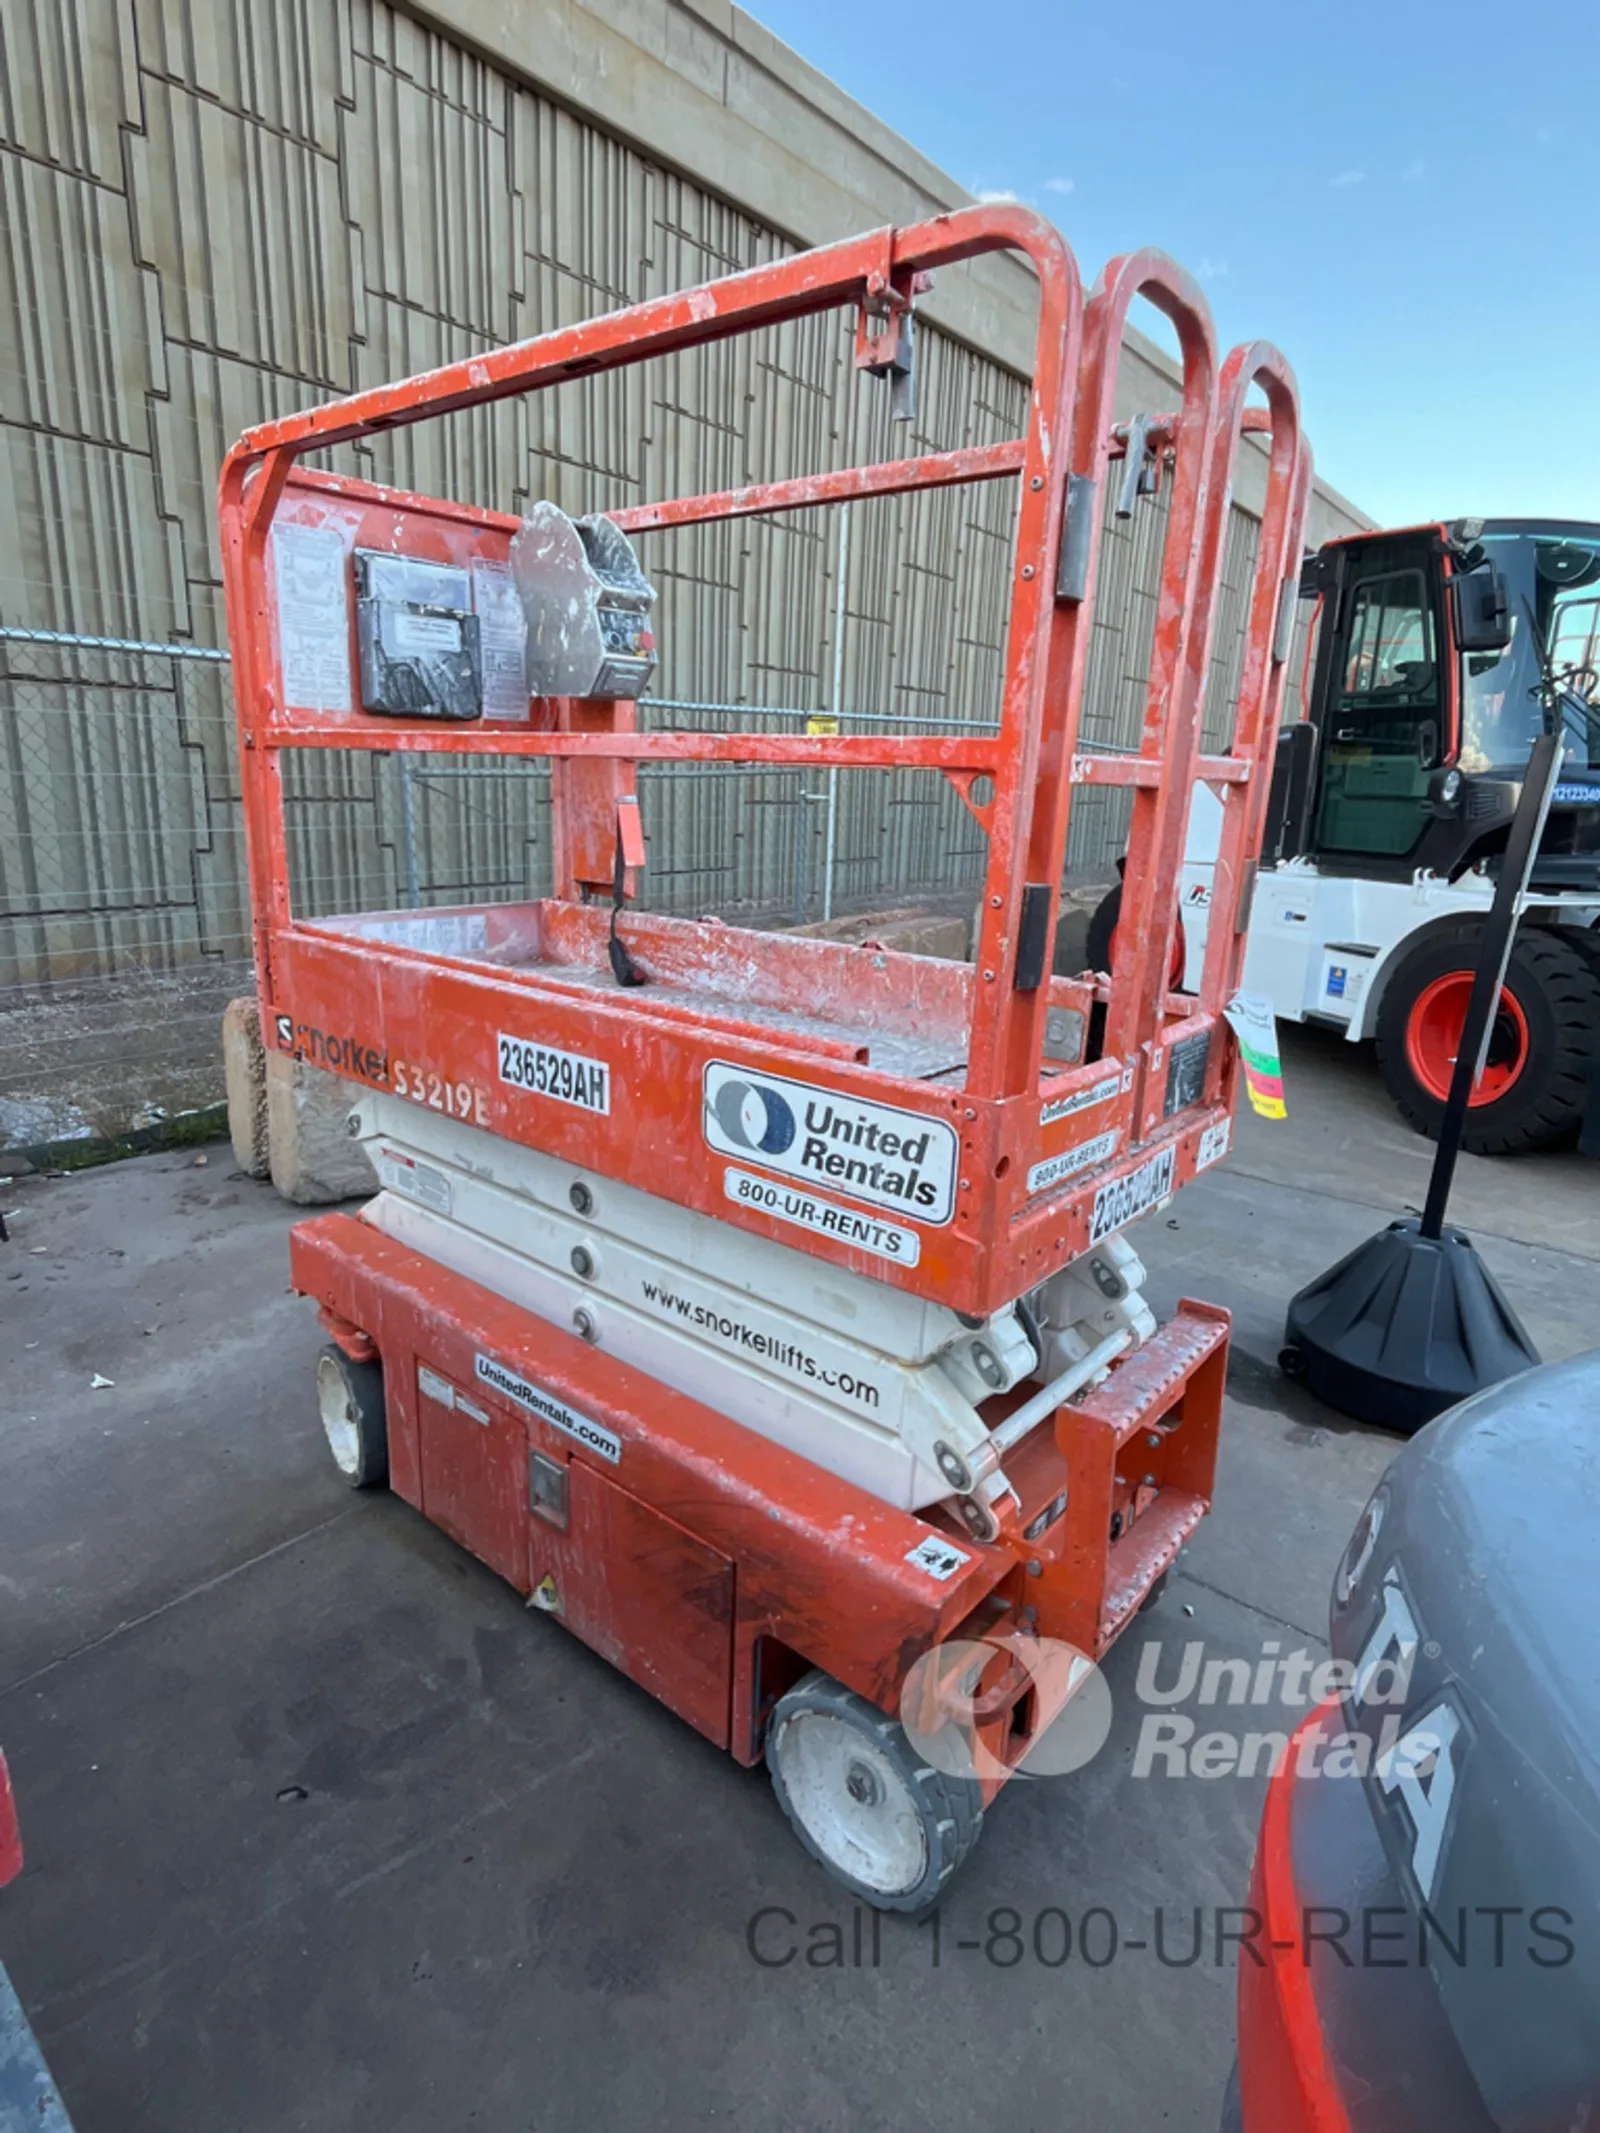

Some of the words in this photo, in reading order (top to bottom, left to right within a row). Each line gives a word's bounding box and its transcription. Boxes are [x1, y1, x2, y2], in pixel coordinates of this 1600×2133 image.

[394, 1060, 491, 1125] S3219E
[499, 1041, 606, 1110] 236529AH
[804, 1101, 930, 1165] United
[801, 1137, 938, 1207] Rentals
[738, 1179, 901, 1253] 800-UR-RENTS
[642, 1280, 880, 1407] www.snorkellifts.com
[478, 1359, 617, 1457] UnitedRentals.com
